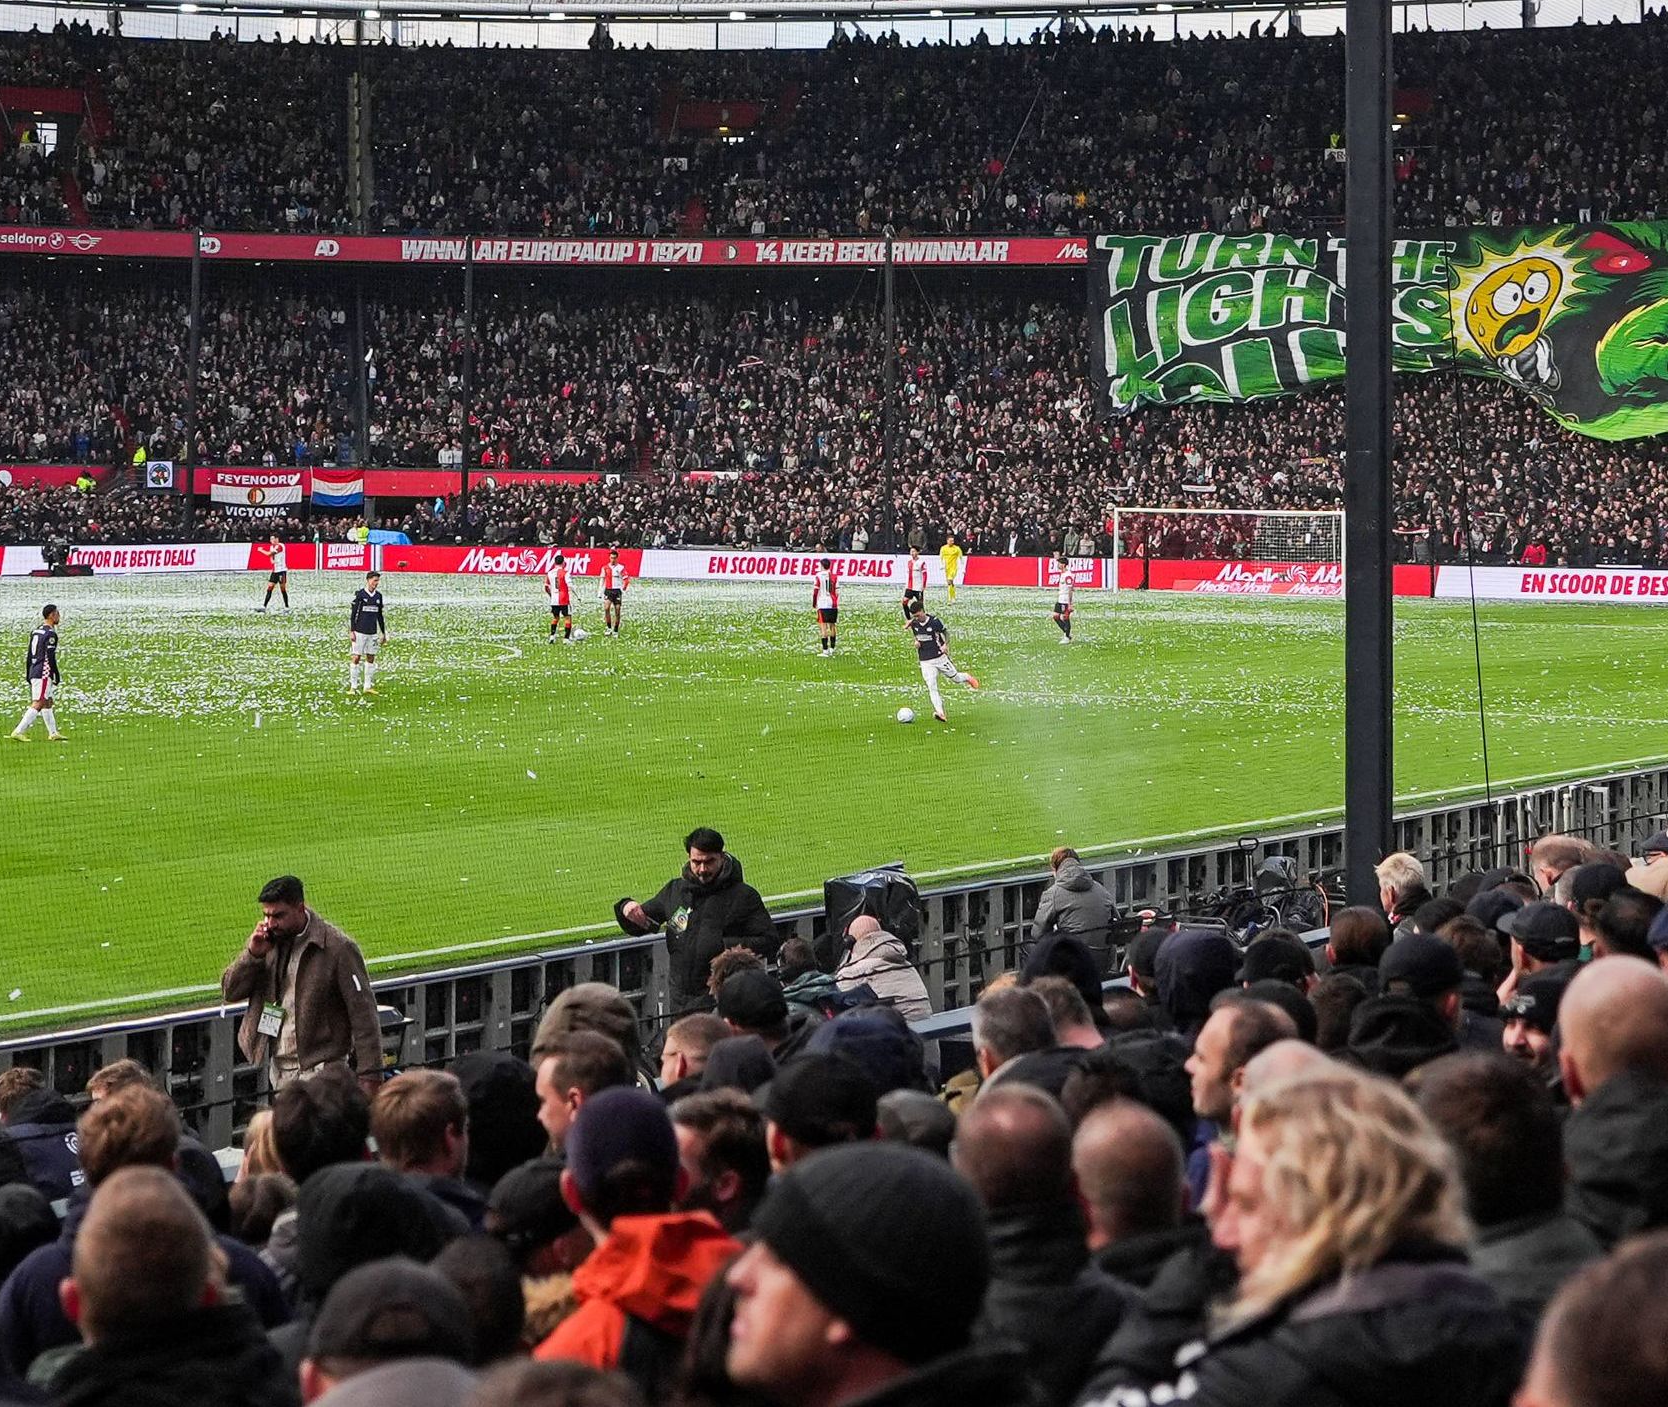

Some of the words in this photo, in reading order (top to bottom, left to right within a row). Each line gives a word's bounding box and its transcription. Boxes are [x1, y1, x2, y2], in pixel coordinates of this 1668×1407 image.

[314, 239, 340, 256] AD
[401, 240, 509, 261] WINNAAR
[508, 241, 635, 262] EUROPACUP
[651, 243, 703, 262] 1970
[755, 243, 778, 262] 14
[778, 243, 835, 262] KEER
[835, 242, 1009, 263] BEKERWINNAAR
[1095, 233, 1319, 298] TURN
[1105, 266, 1454, 378] LIGHS
[225, 505, 288, 518] VICTORIA
[113, 552, 128, 568] DE
[129, 550, 162, 567] BESTE
[163, 549, 196, 567] DEALS
[457, 548, 520, 573] Media
[708, 557, 729, 574] EN
[730, 557, 776, 575] SCOOR
[779, 558, 799, 576] DE
[801, 558, 845, 577] BETE
[847, 559, 894, 578] DEALS
[1520, 573, 1546, 593] EN
[1547, 574, 1607, 595] SCOOR
[1609, 576, 1635, 596] DE
